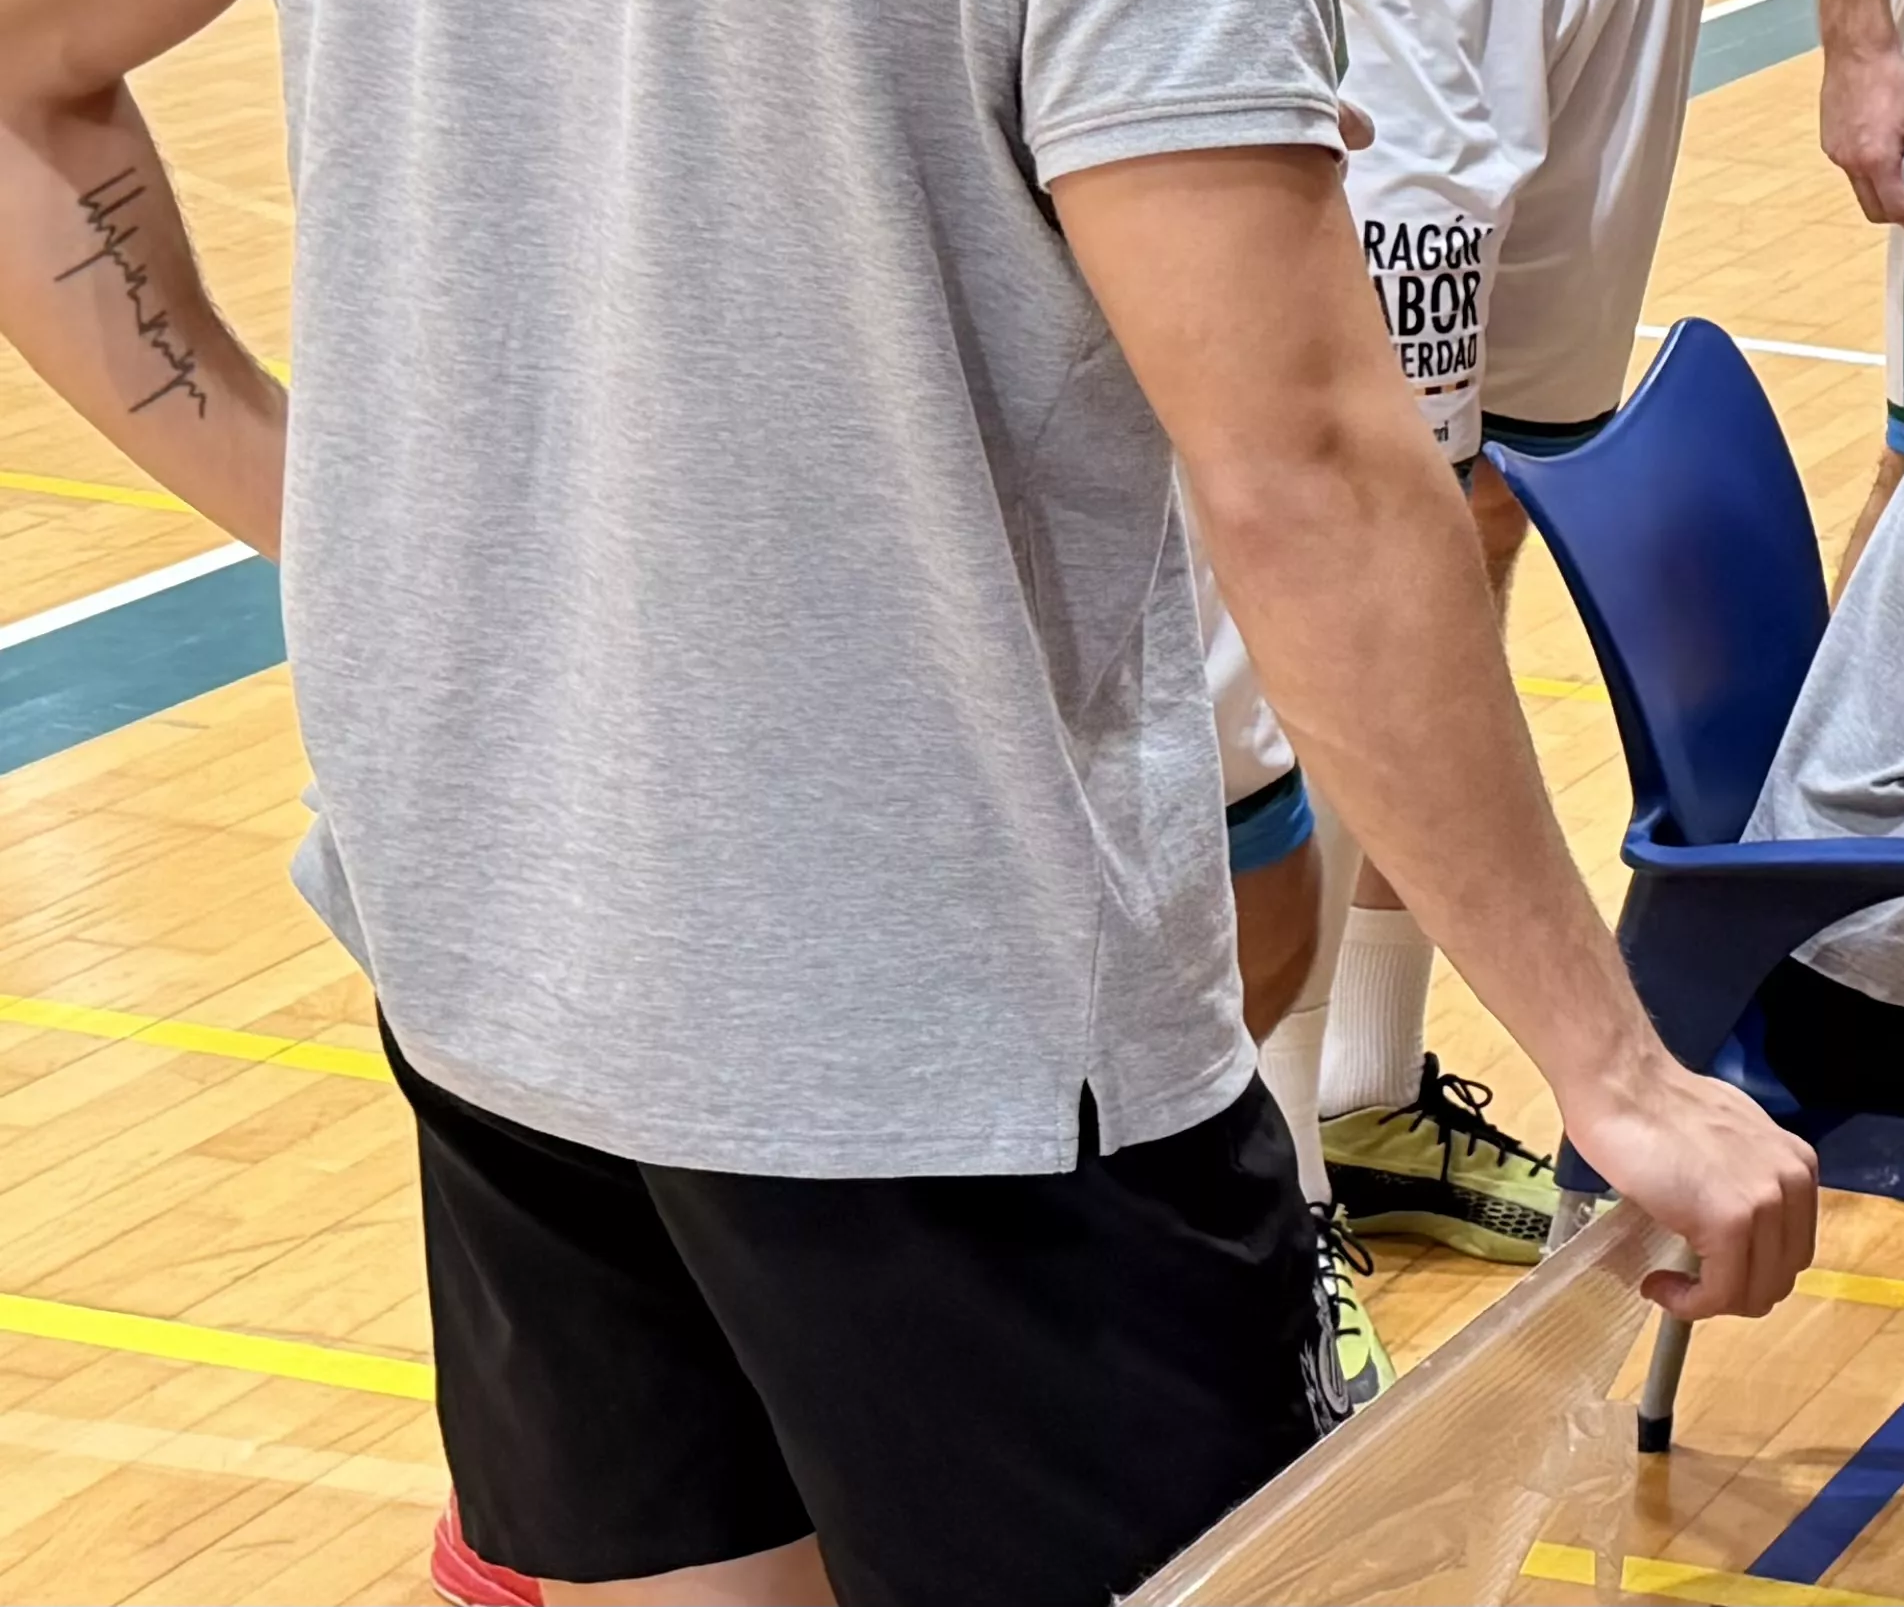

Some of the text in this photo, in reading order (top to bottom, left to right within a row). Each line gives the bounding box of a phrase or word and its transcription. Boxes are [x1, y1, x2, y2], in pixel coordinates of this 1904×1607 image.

[1363, 214, 1493, 272] RAGÓN
[1373, 270, 1481, 336] BOR
[1394, 332, 1477, 379] ERDAD
